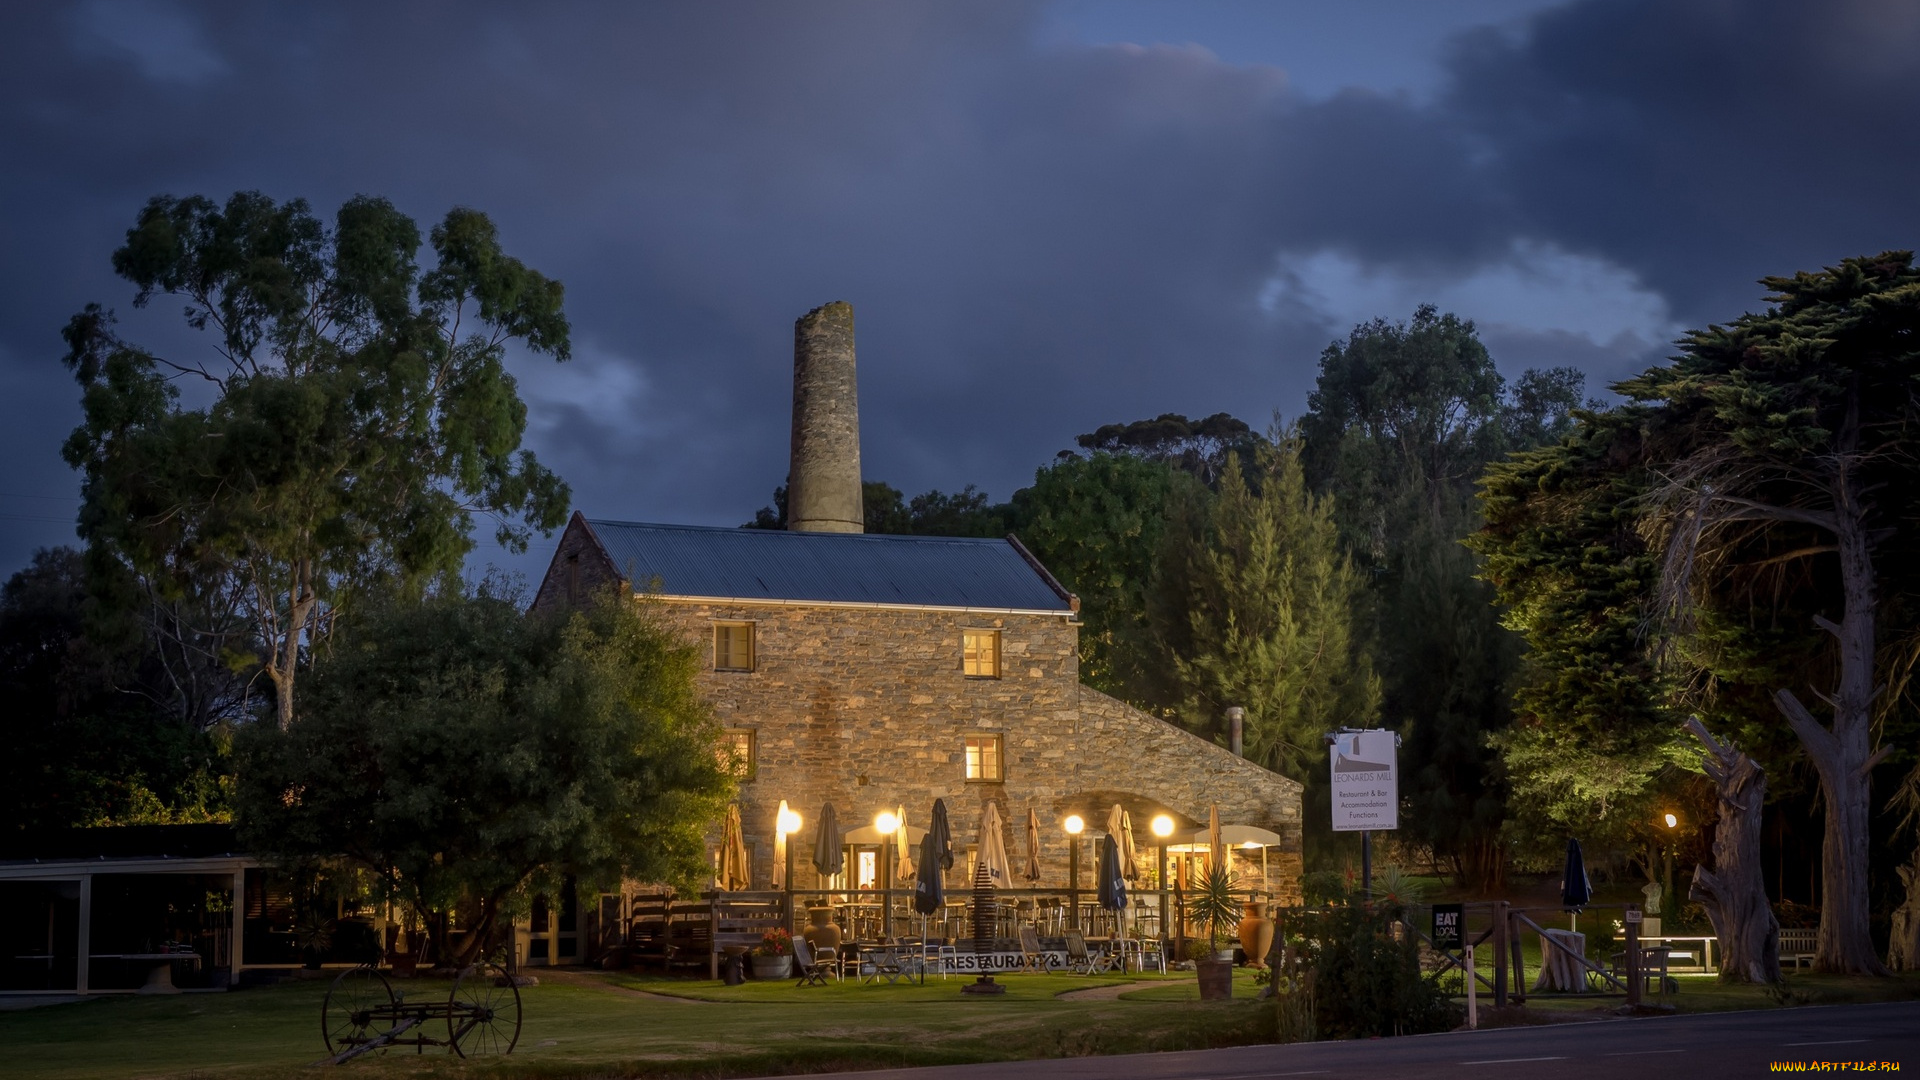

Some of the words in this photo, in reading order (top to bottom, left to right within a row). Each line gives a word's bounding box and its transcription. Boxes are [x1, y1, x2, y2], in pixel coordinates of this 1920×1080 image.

[1334, 773, 1374, 782] LEONARDS
[1376, 772, 1392, 781] MILL
[1341, 800, 1388, 809] Accommodation
[1349, 811, 1379, 819] Functions
[1435, 912, 1458, 926] EAT
[1435, 926, 1458, 936] LOCAL
[1050, 954, 1061, 967] &
